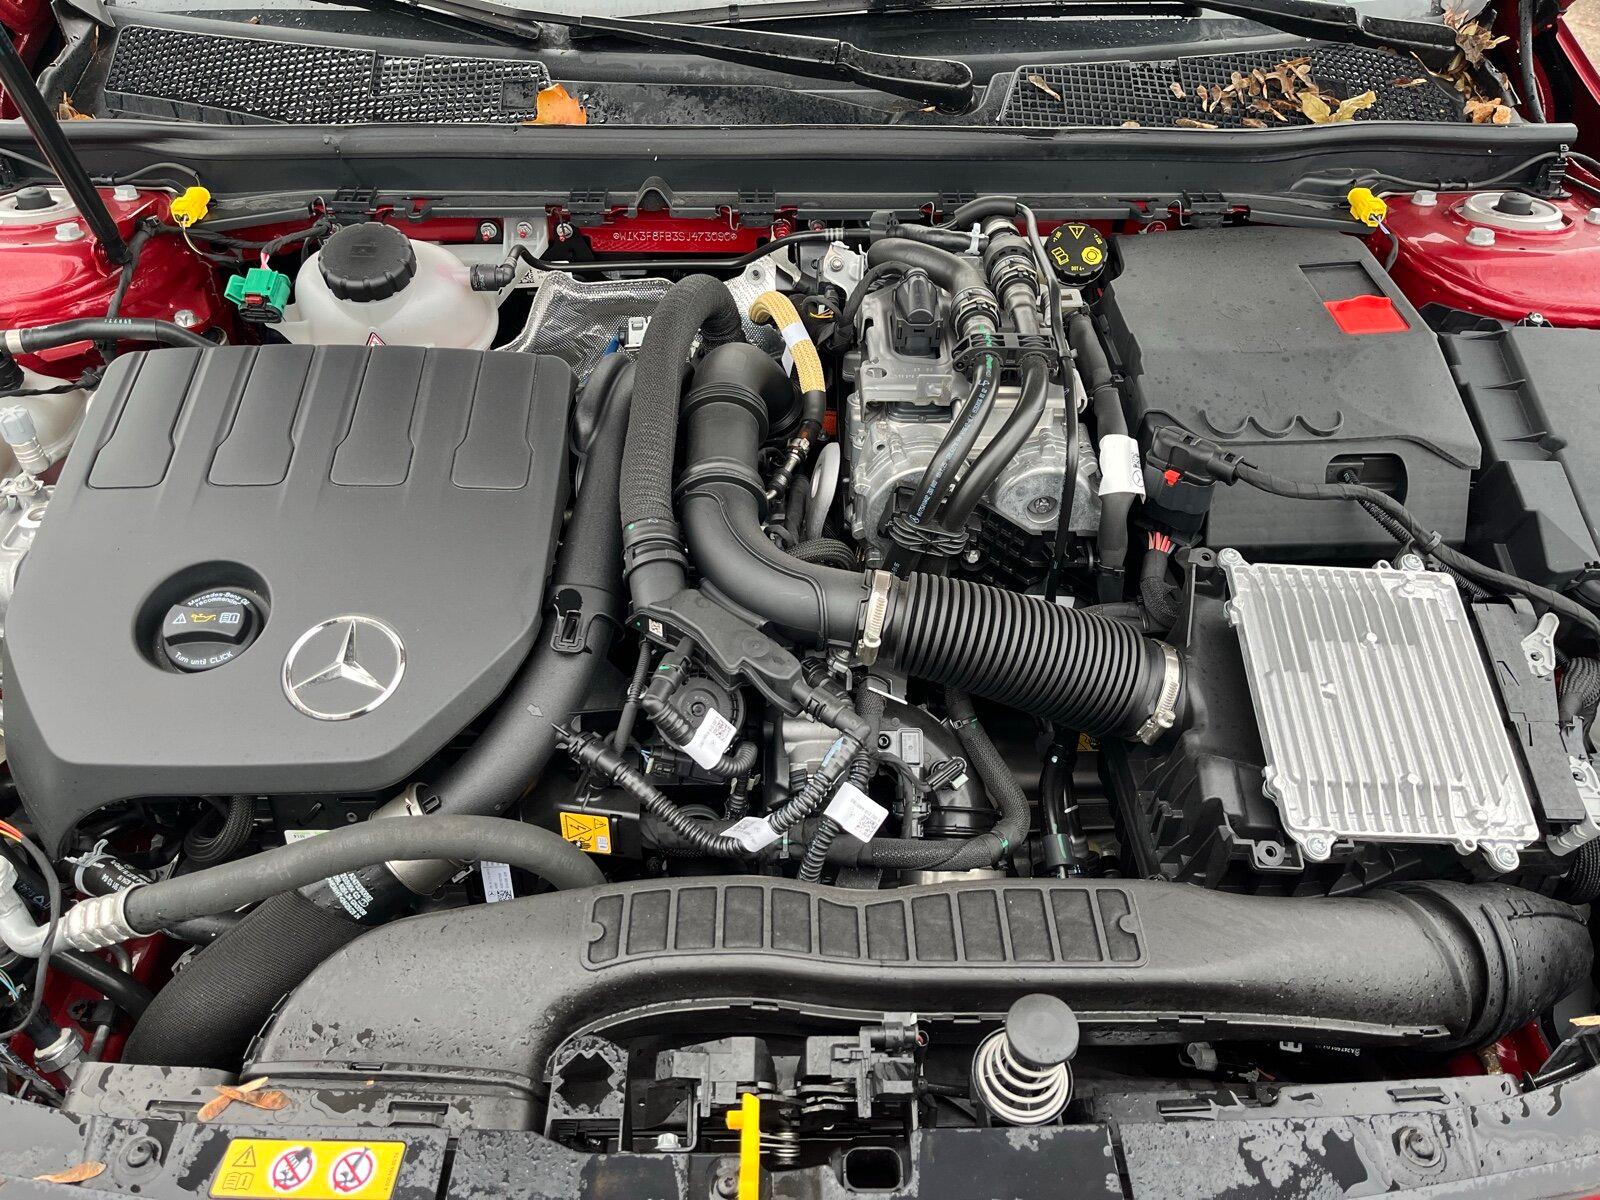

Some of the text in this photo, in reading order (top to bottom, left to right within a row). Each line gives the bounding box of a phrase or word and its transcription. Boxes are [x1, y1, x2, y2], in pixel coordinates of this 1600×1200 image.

[187, 592, 241, 606] Mercedes-Benz
[174, 651, 189, 663] Turn
[209, 651, 234, 664] CLICK
